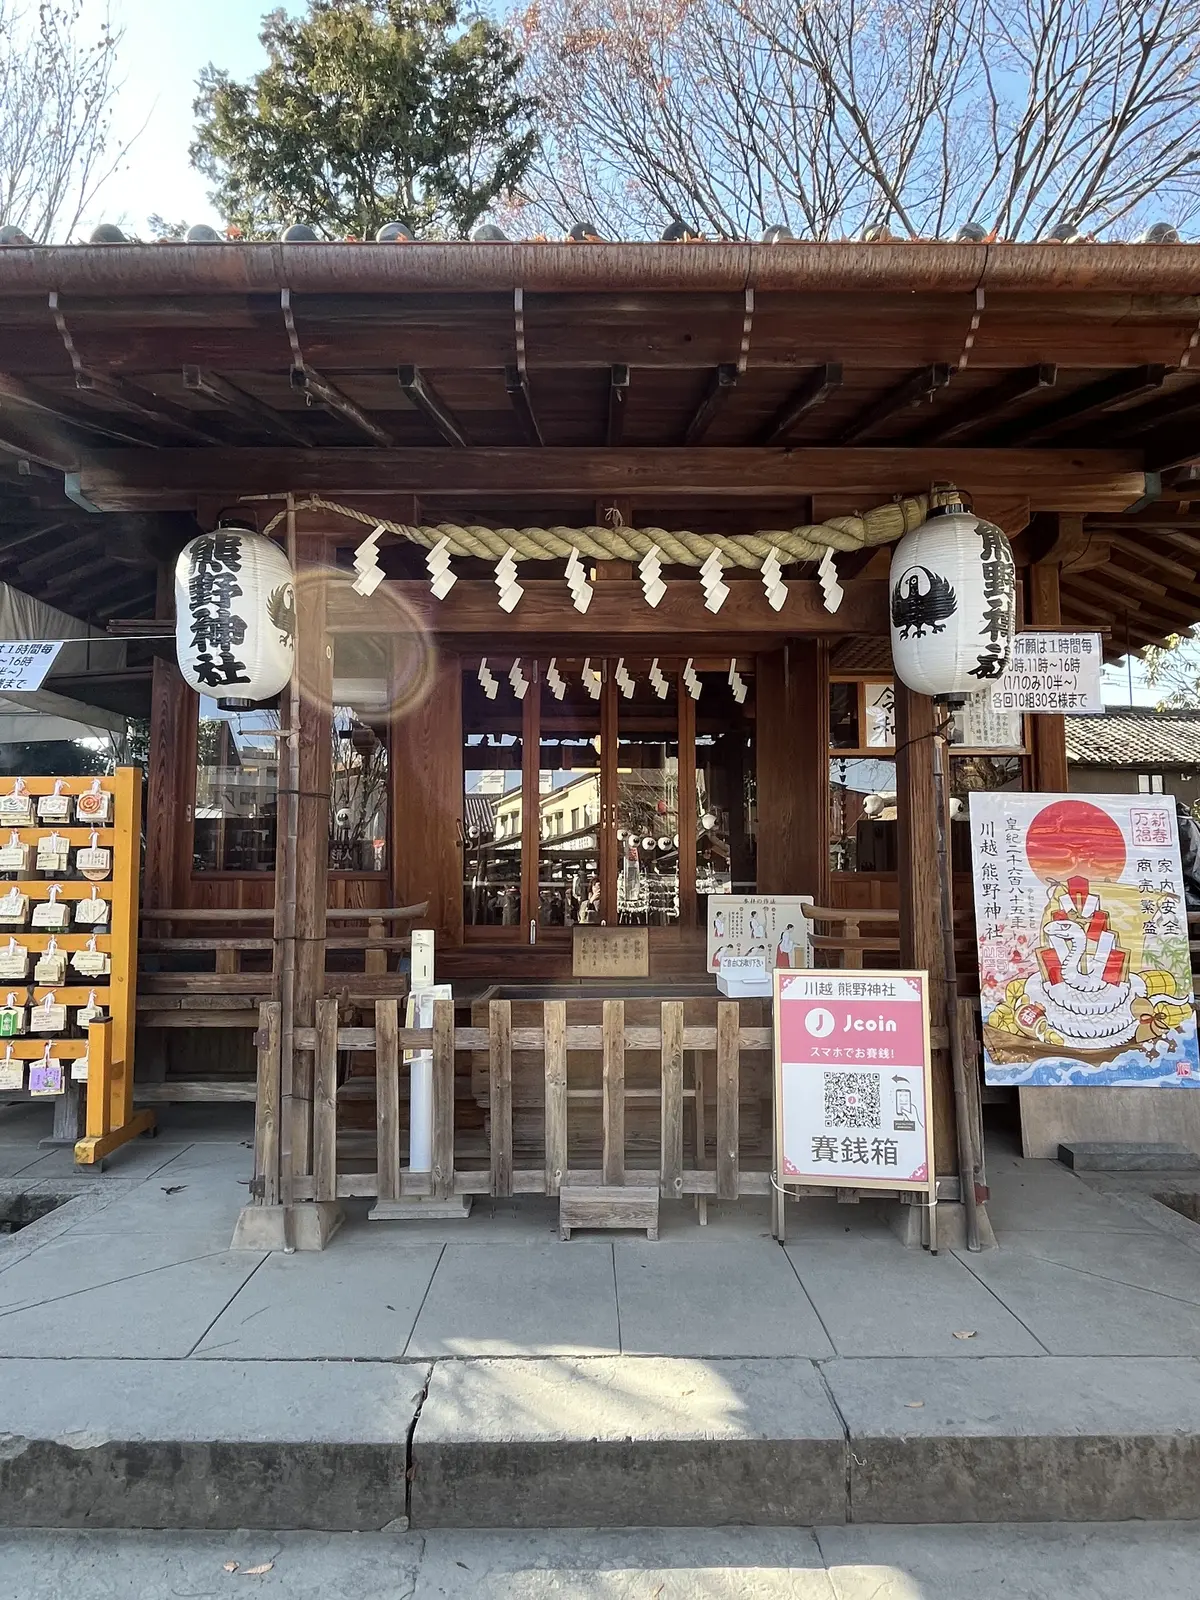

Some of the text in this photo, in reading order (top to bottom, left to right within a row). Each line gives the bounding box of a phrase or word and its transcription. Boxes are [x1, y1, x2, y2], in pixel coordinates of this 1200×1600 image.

[189, 534, 252, 687] 熊野神社
[992, 693, 1088, 708] 各回10組30名様まで
[1134, 812, 1151, 842] 万福
[1151, 812, 1168, 843] 新春
[980, 821, 1003, 940] 川越 熊野神社
[1136, 858, 1157, 935] 商売繁盛
[1158, 858, 1179, 935] 家内安全
[804, 982, 896, 997] 川越 熊野神社
[843, 1014, 897, 1032] Jcoin
[1021, 1007, 1038, 1025] 福
[811, 1135, 899, 1166] 賽銭箱
